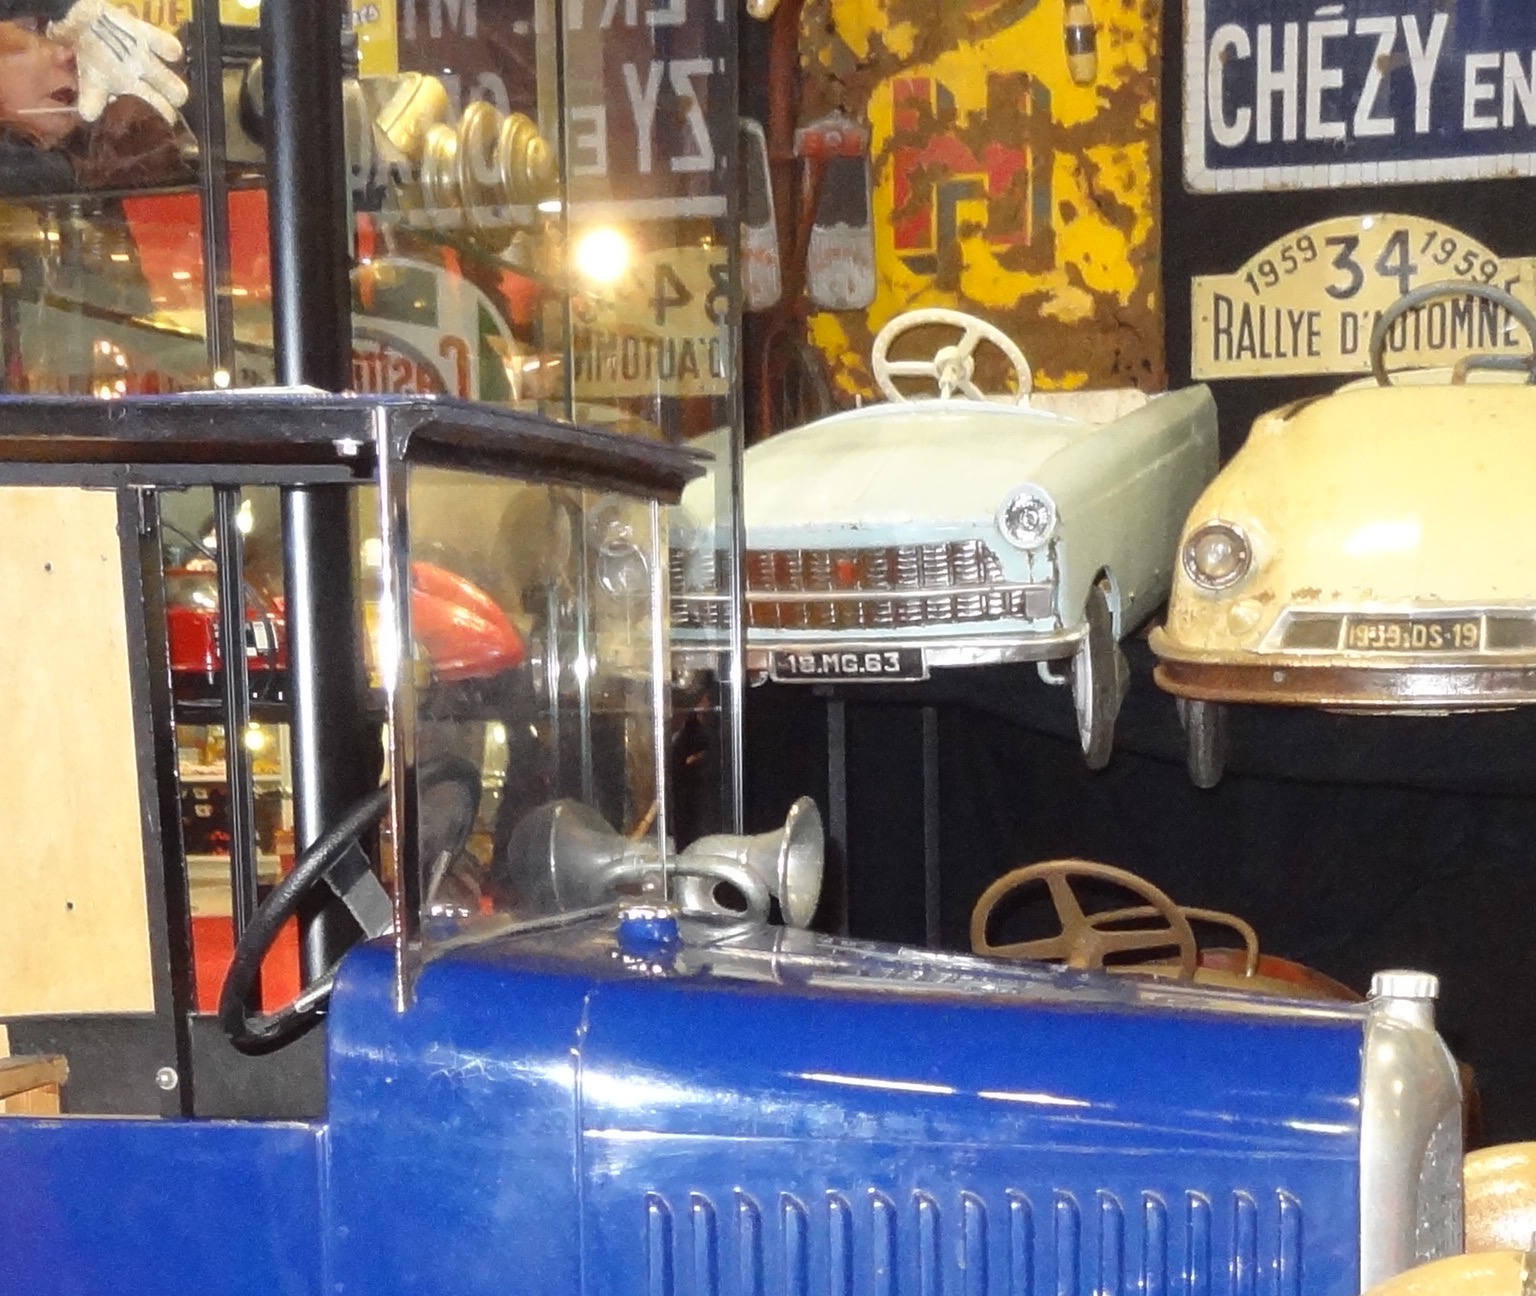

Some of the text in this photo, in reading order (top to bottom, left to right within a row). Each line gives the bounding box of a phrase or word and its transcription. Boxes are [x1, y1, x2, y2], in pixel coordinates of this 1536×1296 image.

[1207, 4, 1449, 147] CHÉZY
[1243, 228, 1499, 300] 1959 34 1959
[1214, 292, 1321, 361] RALLYE
